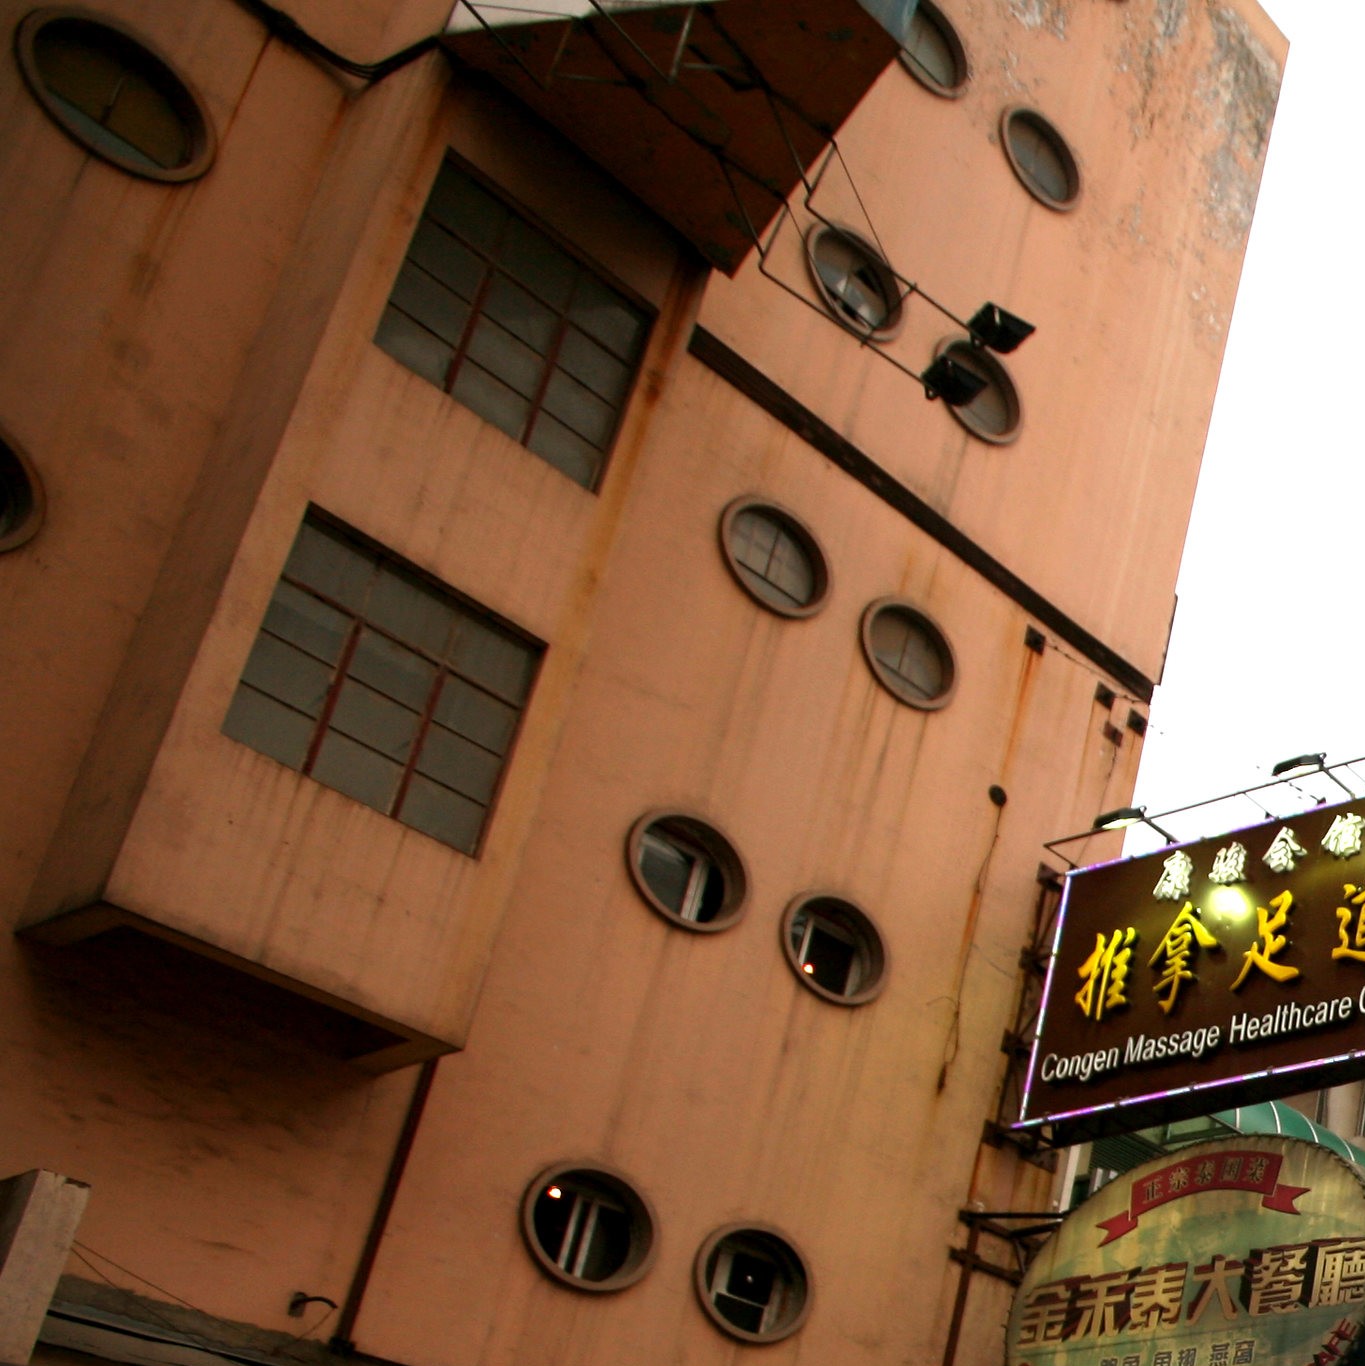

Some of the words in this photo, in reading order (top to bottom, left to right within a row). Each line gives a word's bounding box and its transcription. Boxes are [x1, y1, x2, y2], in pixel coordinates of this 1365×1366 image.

[1041, 1048, 1119, 1082] Congen
[1124, 1023, 1220, 1063] Massage
[1230, 991, 1352, 1045] Healthcare
